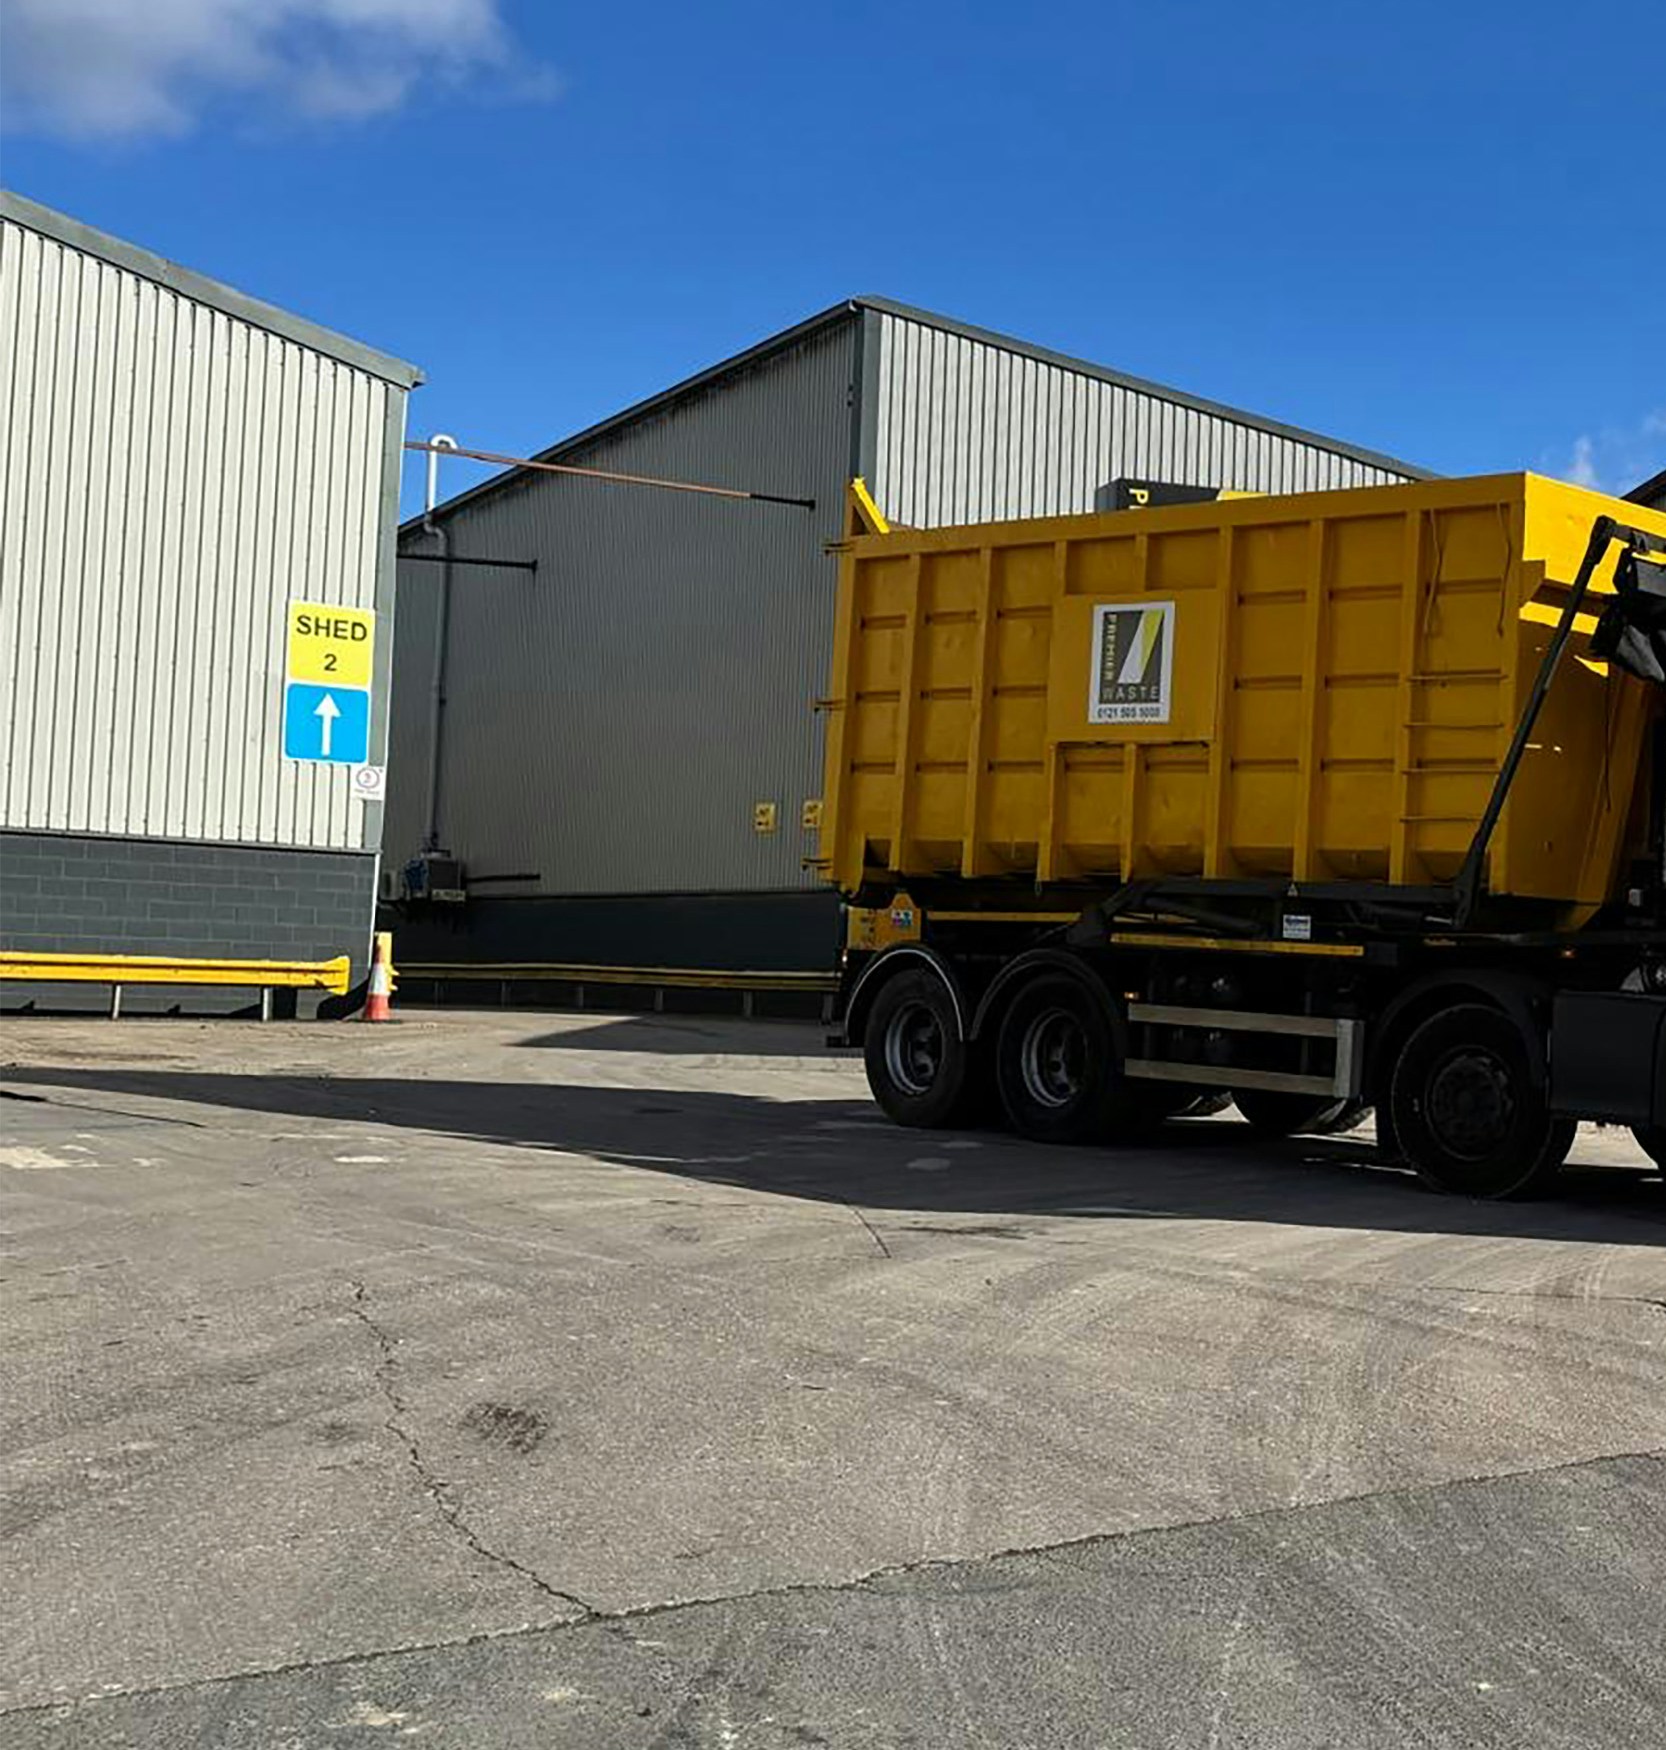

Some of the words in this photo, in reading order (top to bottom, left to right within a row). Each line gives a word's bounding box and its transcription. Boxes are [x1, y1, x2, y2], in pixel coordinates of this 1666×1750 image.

[296, 614, 368, 642] SHED
[1104, 614, 1118, 681] PREMIER
[324, 653, 338, 672] 2
[1102, 686, 1160, 701] WASTE
